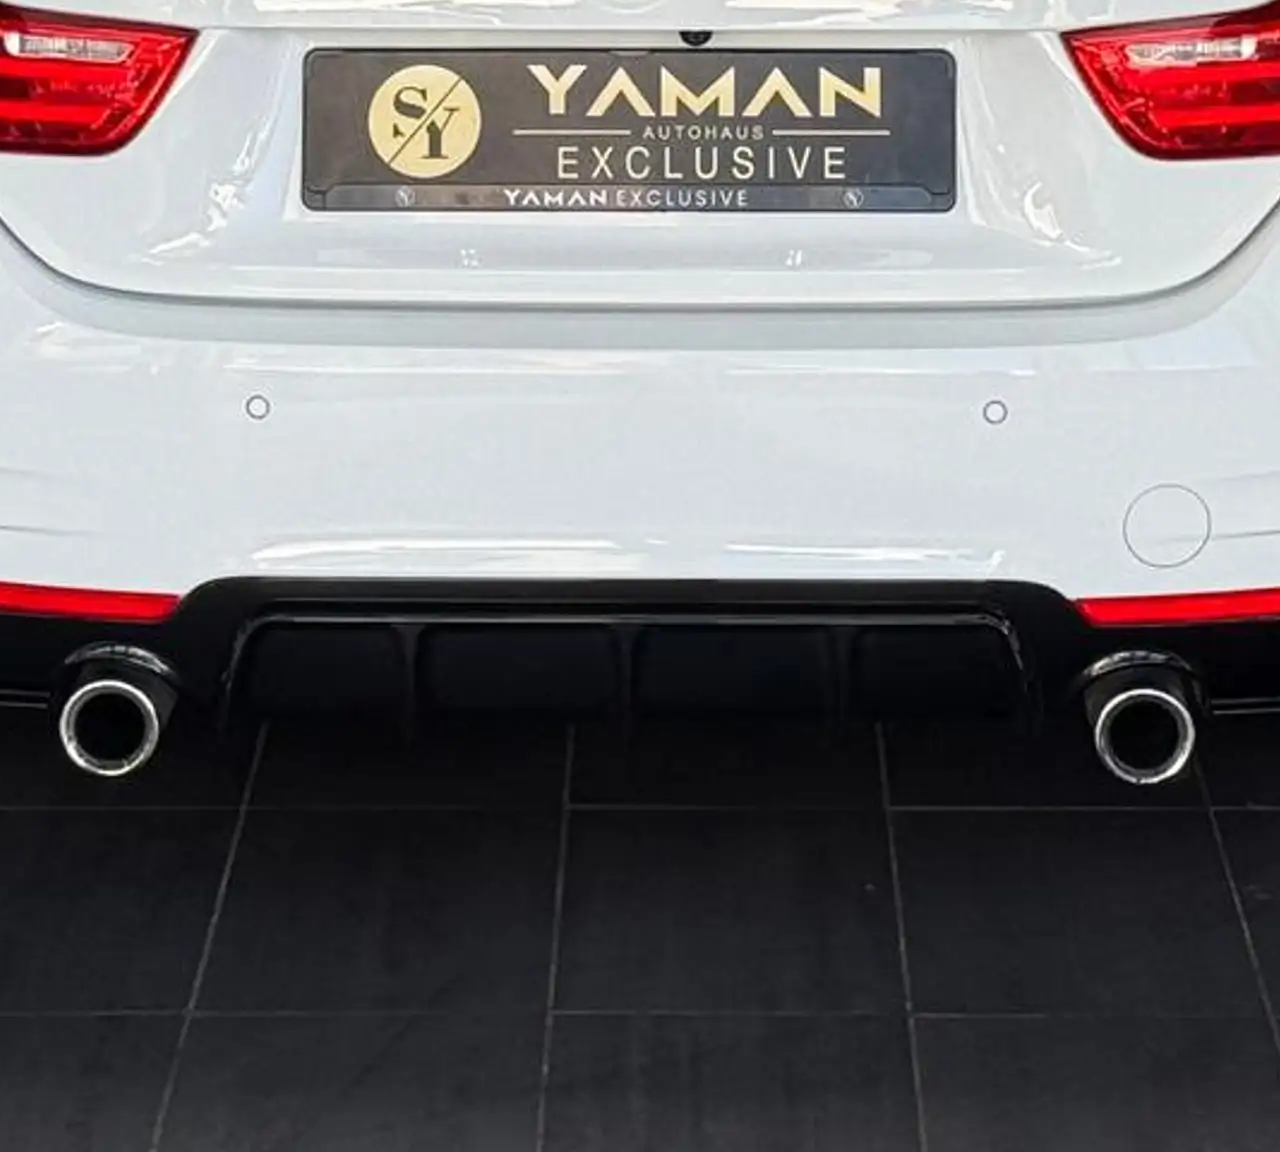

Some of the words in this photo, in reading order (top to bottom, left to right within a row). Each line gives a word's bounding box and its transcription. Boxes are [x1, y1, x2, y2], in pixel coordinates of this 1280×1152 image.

[526, 64, 882, 118] YAMAN
[642, 125, 765, 141] AUTOHAUS
[556, 146, 847, 180] EXCLUSIVE
[503, 188, 608, 207] YAMAN
[615, 189, 749, 208] EXCLUSIVE
